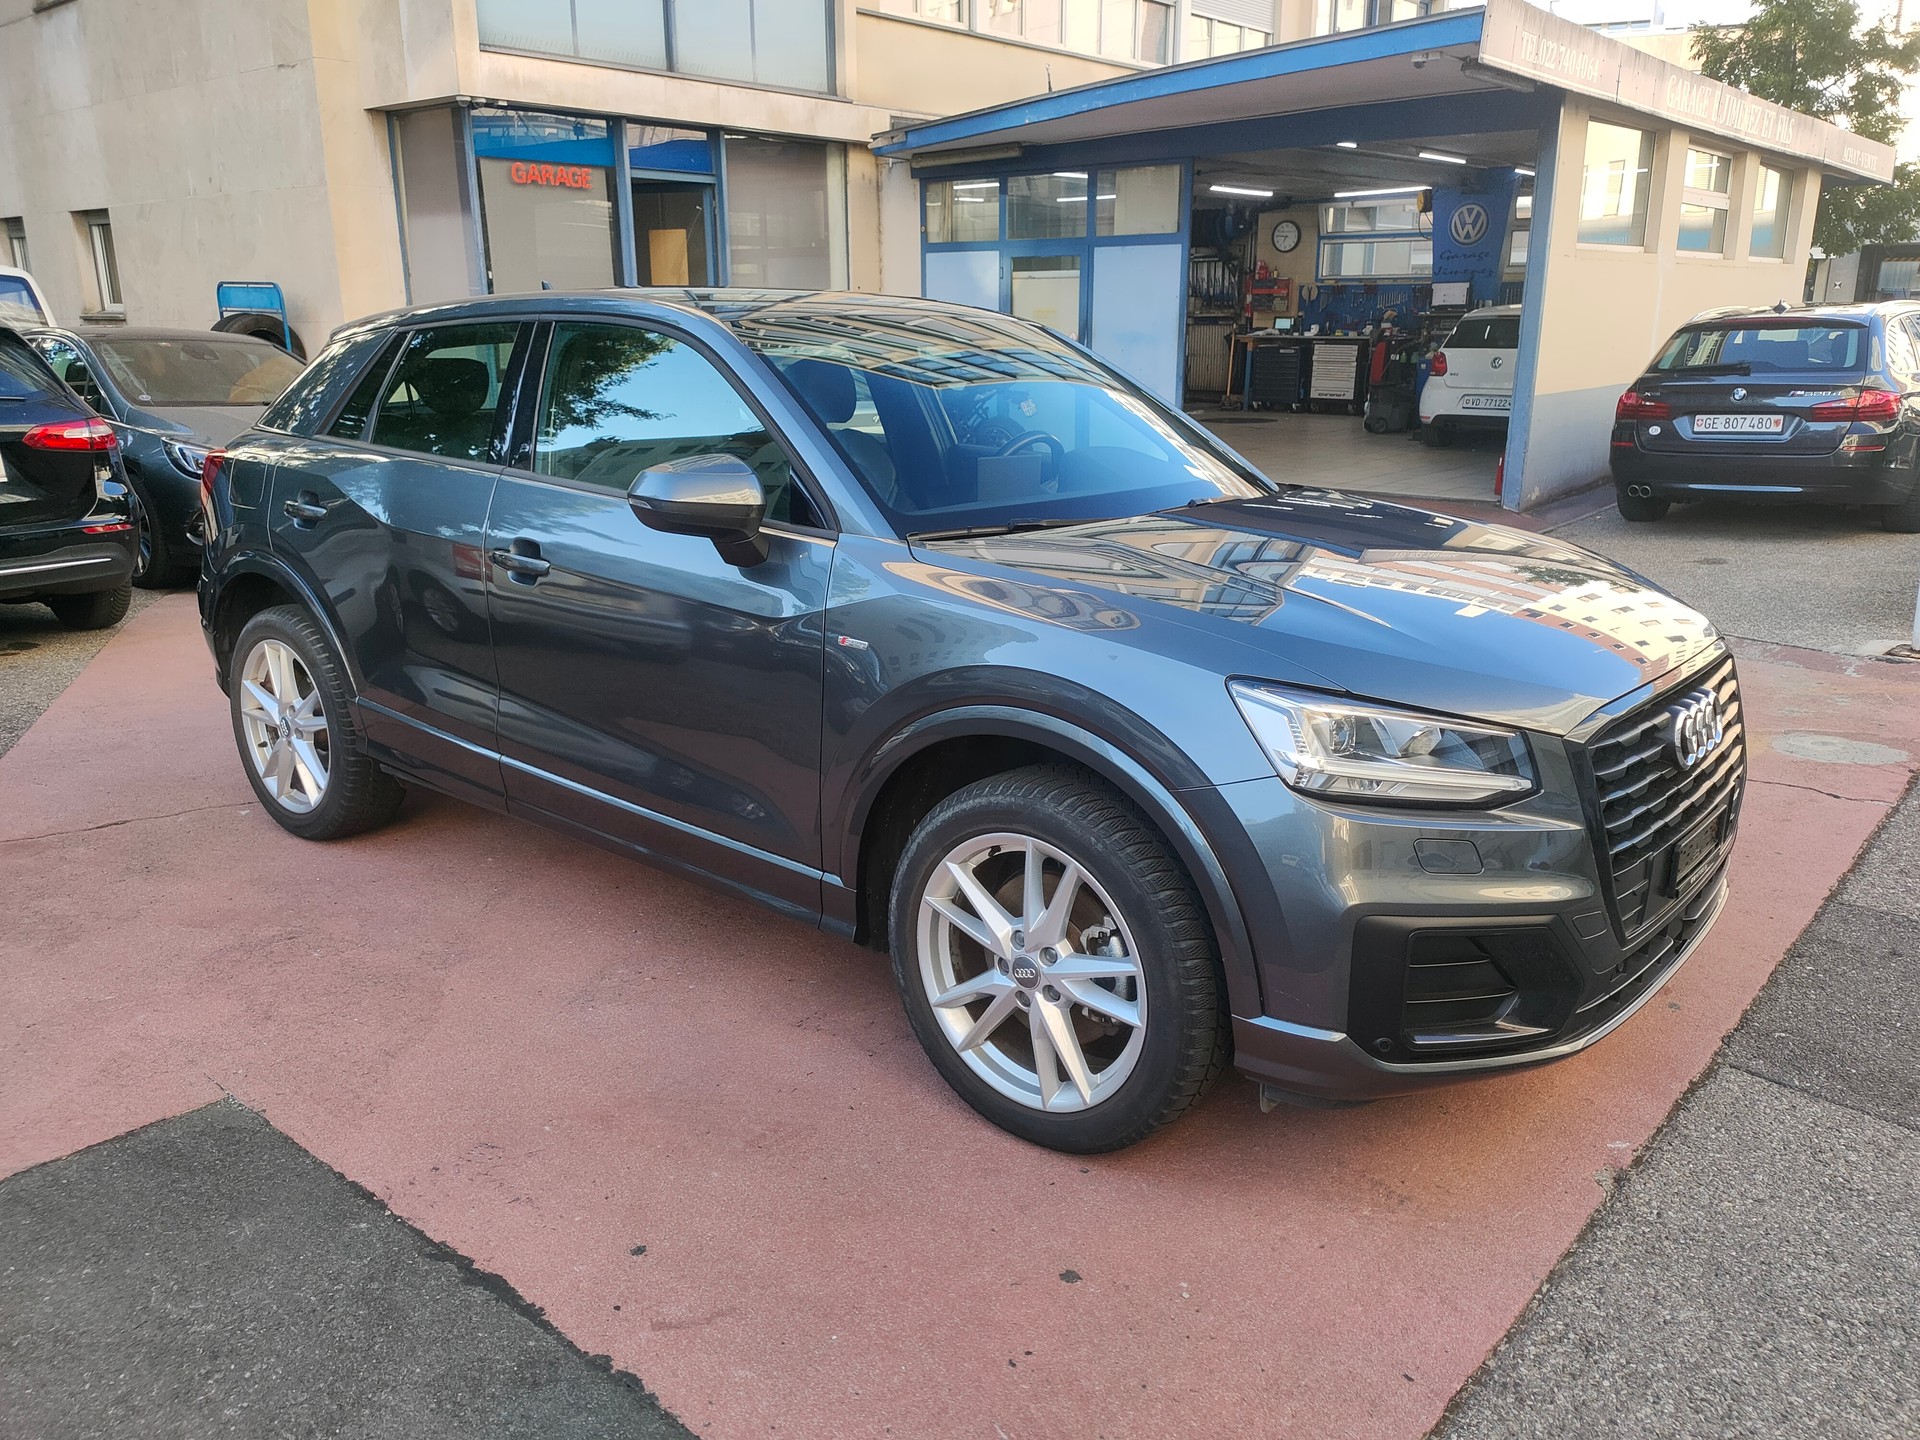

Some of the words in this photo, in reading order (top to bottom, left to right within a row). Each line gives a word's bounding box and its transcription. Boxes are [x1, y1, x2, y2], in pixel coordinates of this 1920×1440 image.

[1666, 74, 1713, 118] GARAGE
[1761, 110, 1777, 139] ET
[1775, 114, 1795, 145] FILS
[511, 161, 593, 189] GARAGE
[1484, 398, 1508, 408] 77122
